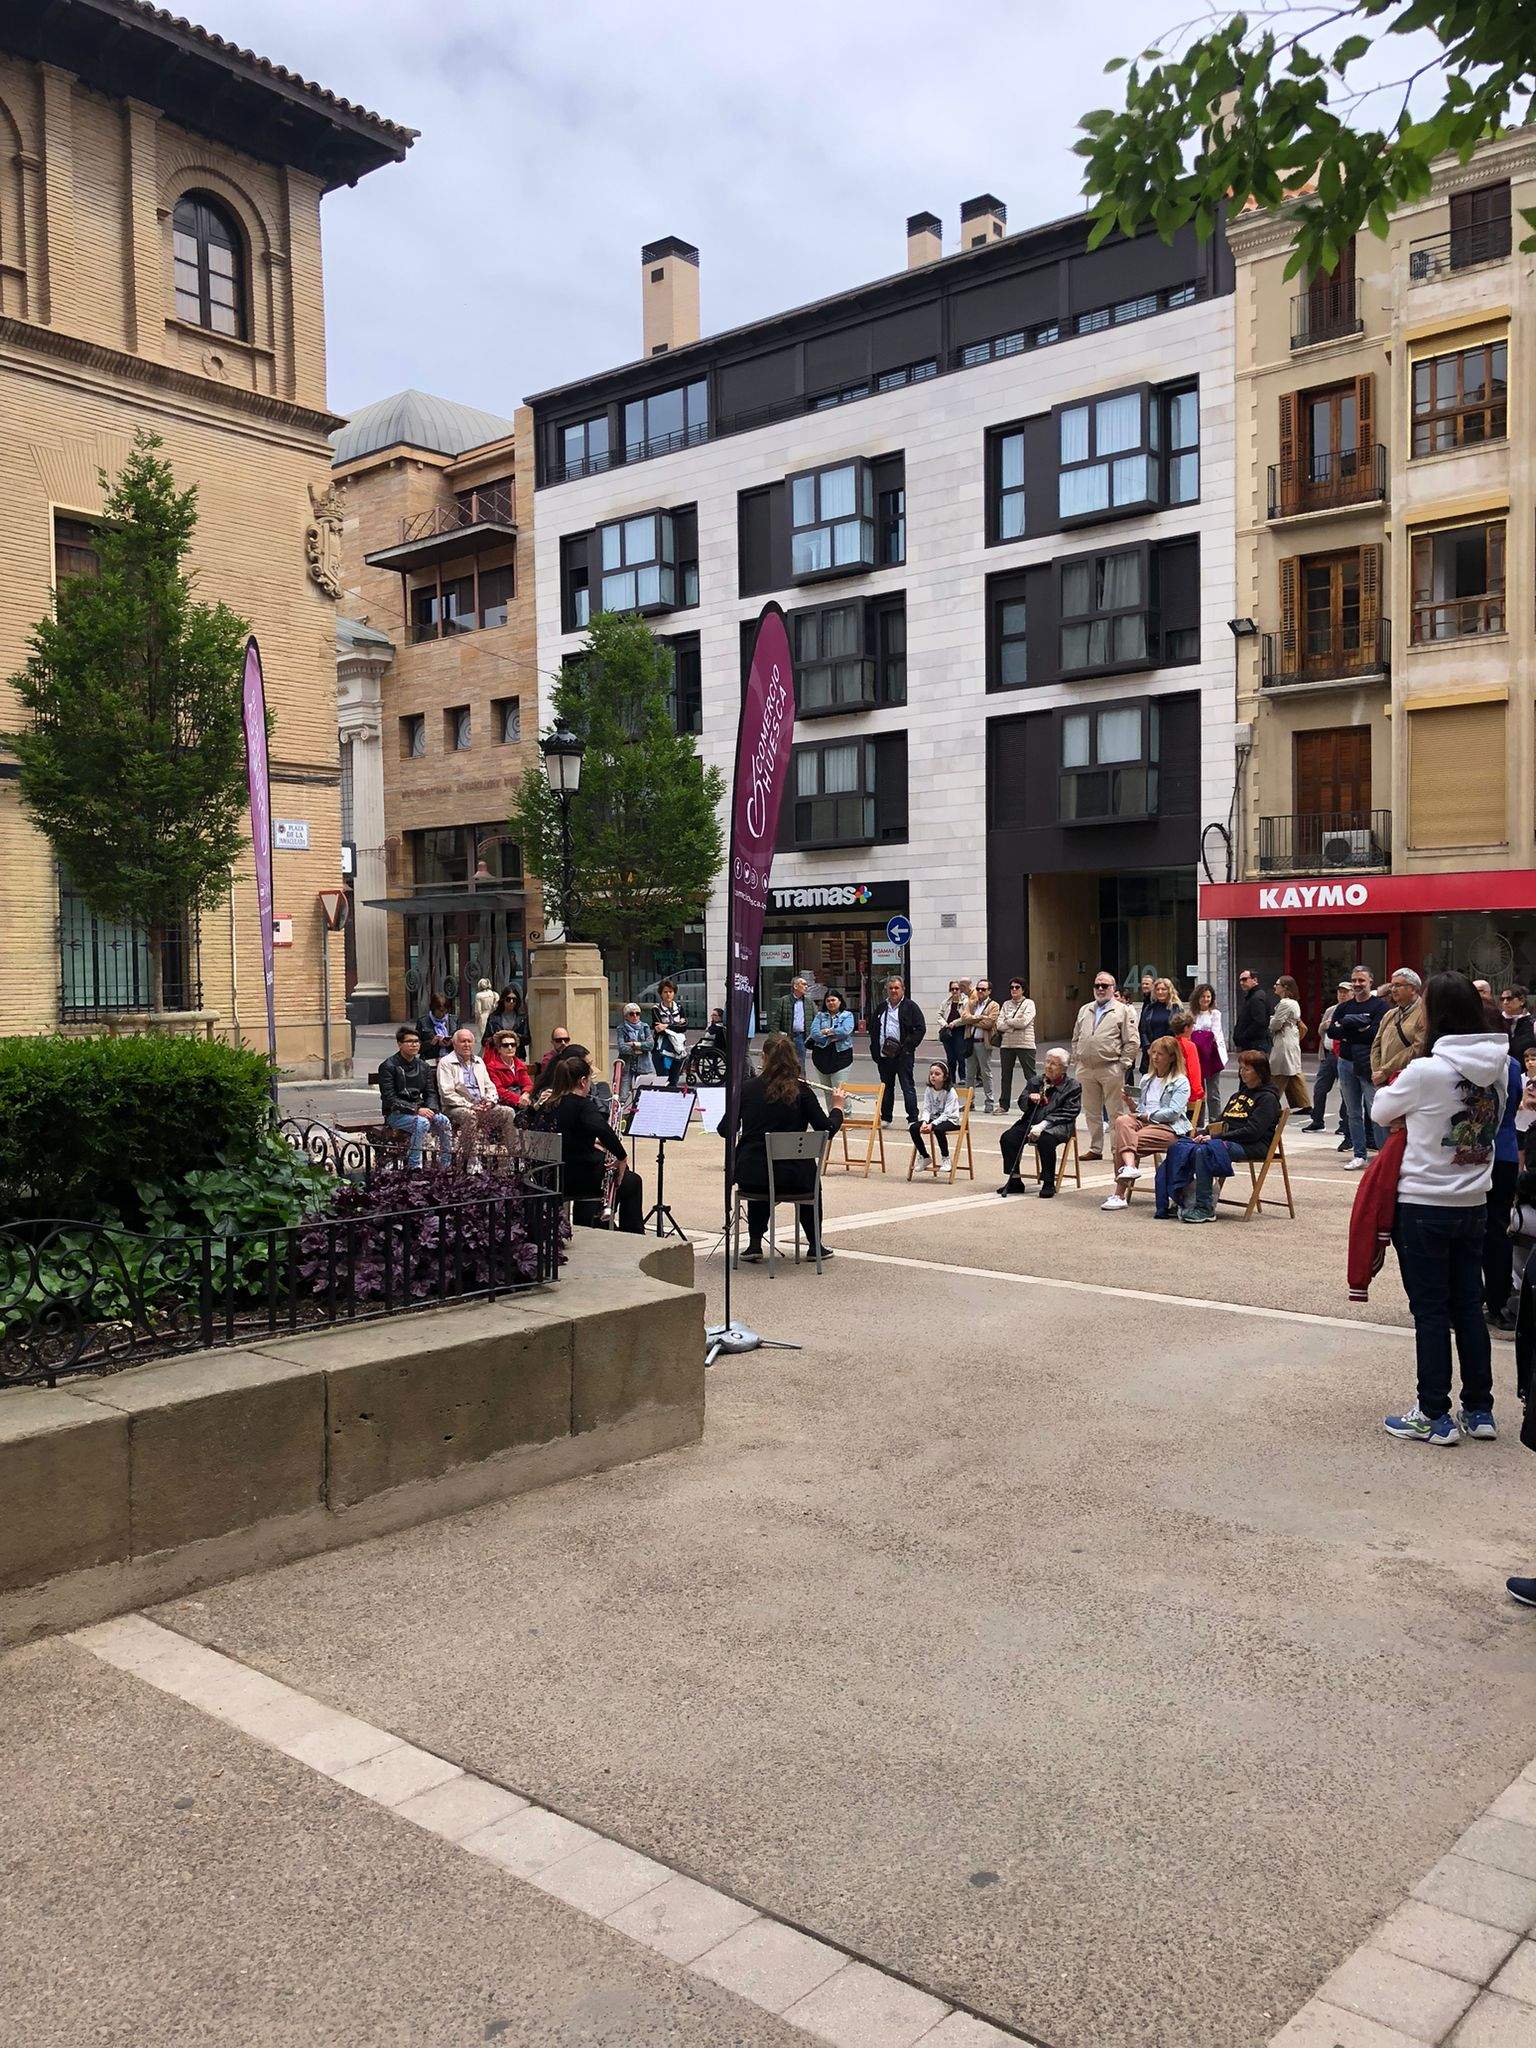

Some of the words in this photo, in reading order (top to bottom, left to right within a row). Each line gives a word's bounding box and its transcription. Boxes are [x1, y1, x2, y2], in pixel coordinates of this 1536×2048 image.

[755, 664, 780, 774] COMERCIO
[762, 684, 788, 794] HUESCA
[1259, 883, 1368, 910] KAYMO
